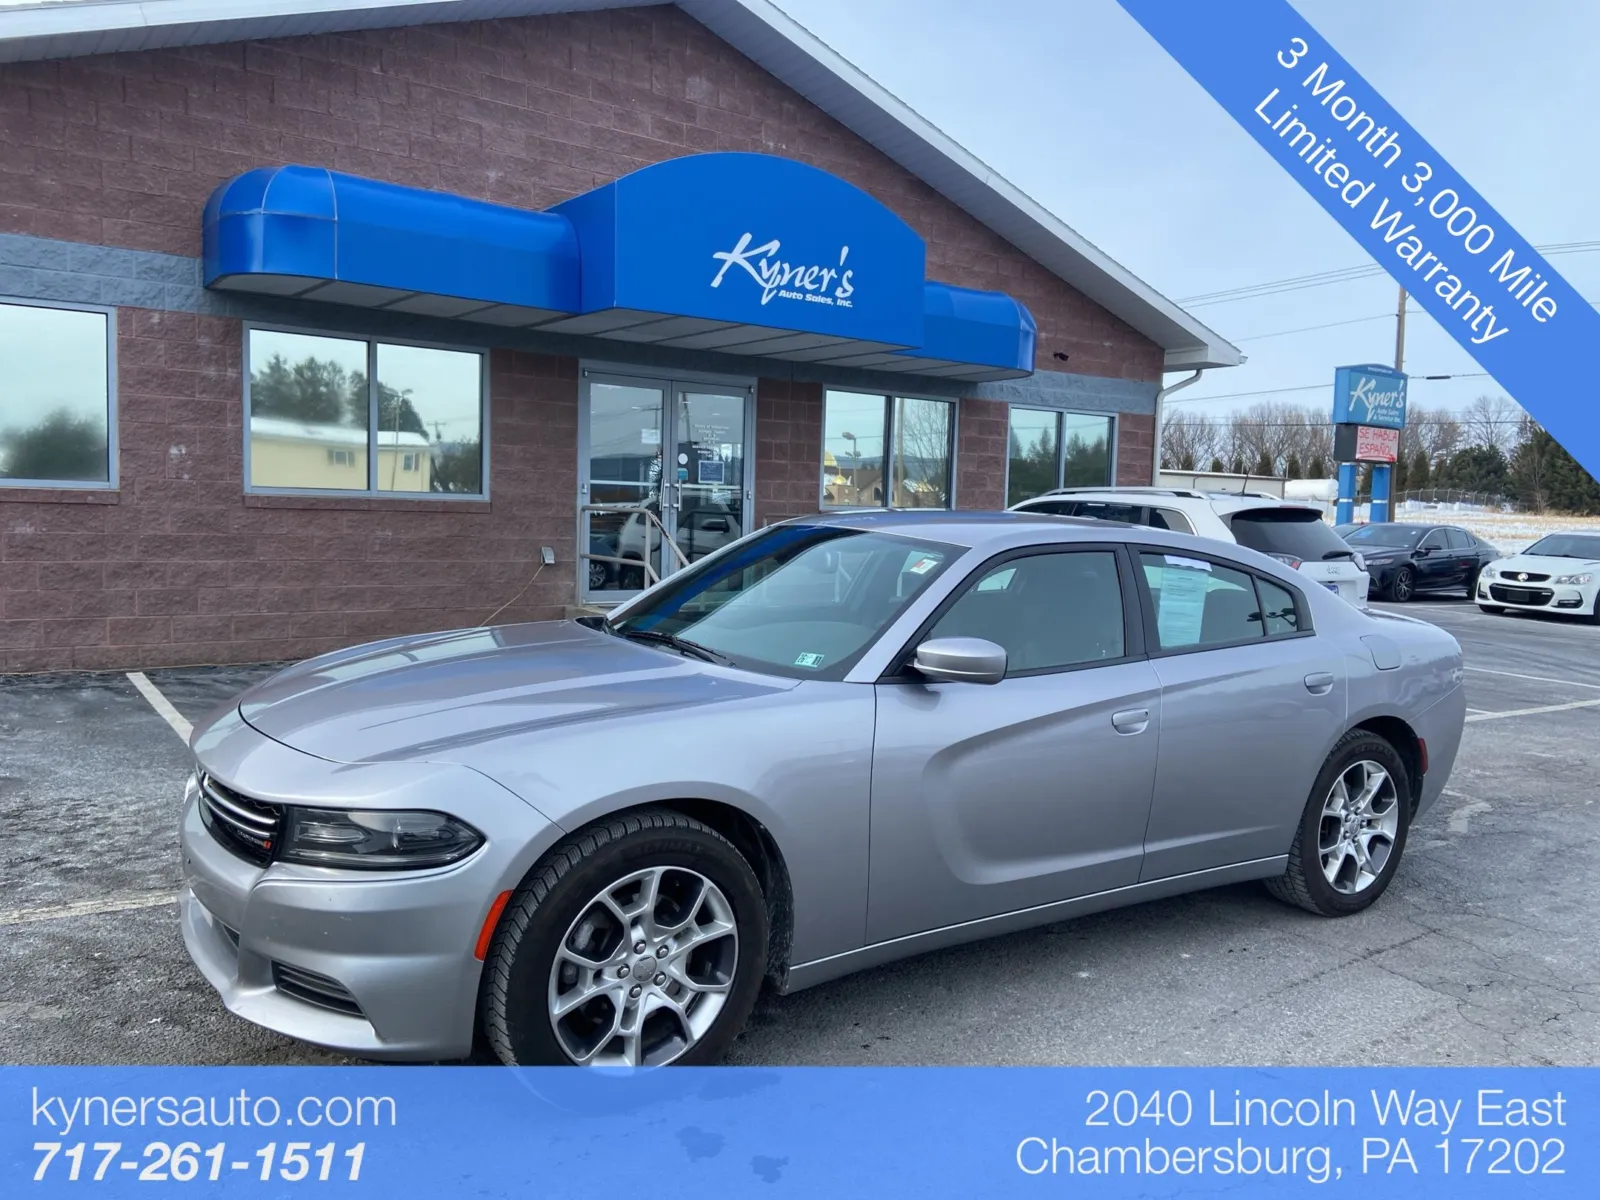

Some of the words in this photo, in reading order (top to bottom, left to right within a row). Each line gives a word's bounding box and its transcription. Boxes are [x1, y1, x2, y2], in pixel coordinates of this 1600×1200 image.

[710, 232, 855, 306] Kyner's
[778, 289, 804, 301] Auto
[804, 293, 834, 306] Sales,
[836, 298, 854, 308] Inc.
[1348, 377, 1404, 423] Kyner's
[1359, 427, 1370, 439] SE
[1372, 428, 1397, 442] HABLA
